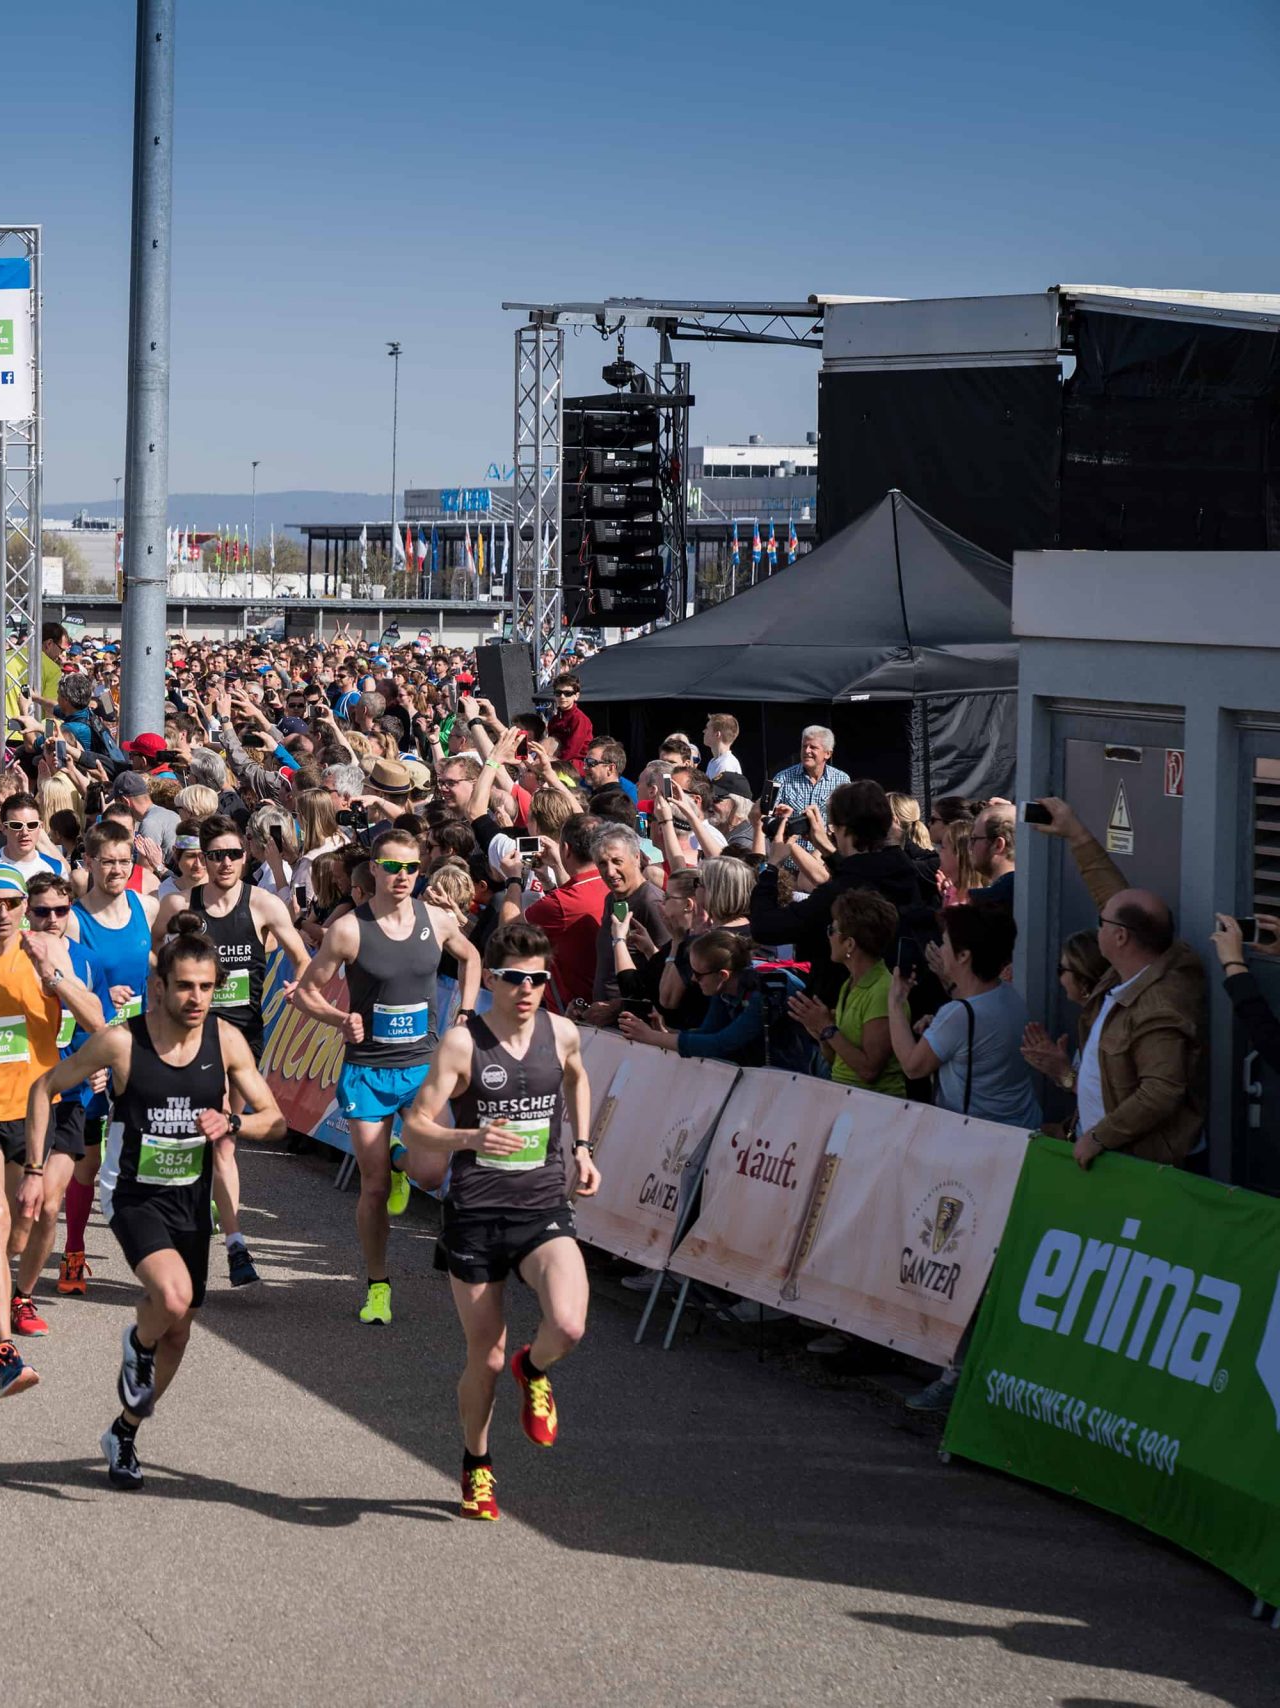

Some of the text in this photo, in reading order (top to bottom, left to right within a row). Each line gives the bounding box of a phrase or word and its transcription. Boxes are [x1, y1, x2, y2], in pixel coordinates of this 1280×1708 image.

[218, 945, 252, 957] CHER
[220, 955, 252, 963] OUTDOOR
[389, 1016, 414, 1027] 432
[388, 1027, 414, 1036] LUKAS
[166, 1096, 191, 1108] TUS
[477, 1094, 557, 1113] DRESCHER
[520, 1108, 555, 1120] OUTDOOR
[150, 1121, 198, 1134] STETTE
[154, 1151, 193, 1166] 3854
[158, 1166, 186, 1175] OMAR
[899, 1246, 962, 1300] GANTER
[1018, 1217, 1241, 1387] erima
[986, 1369, 1181, 1477] SPORTSWEAR SINCE 1900
